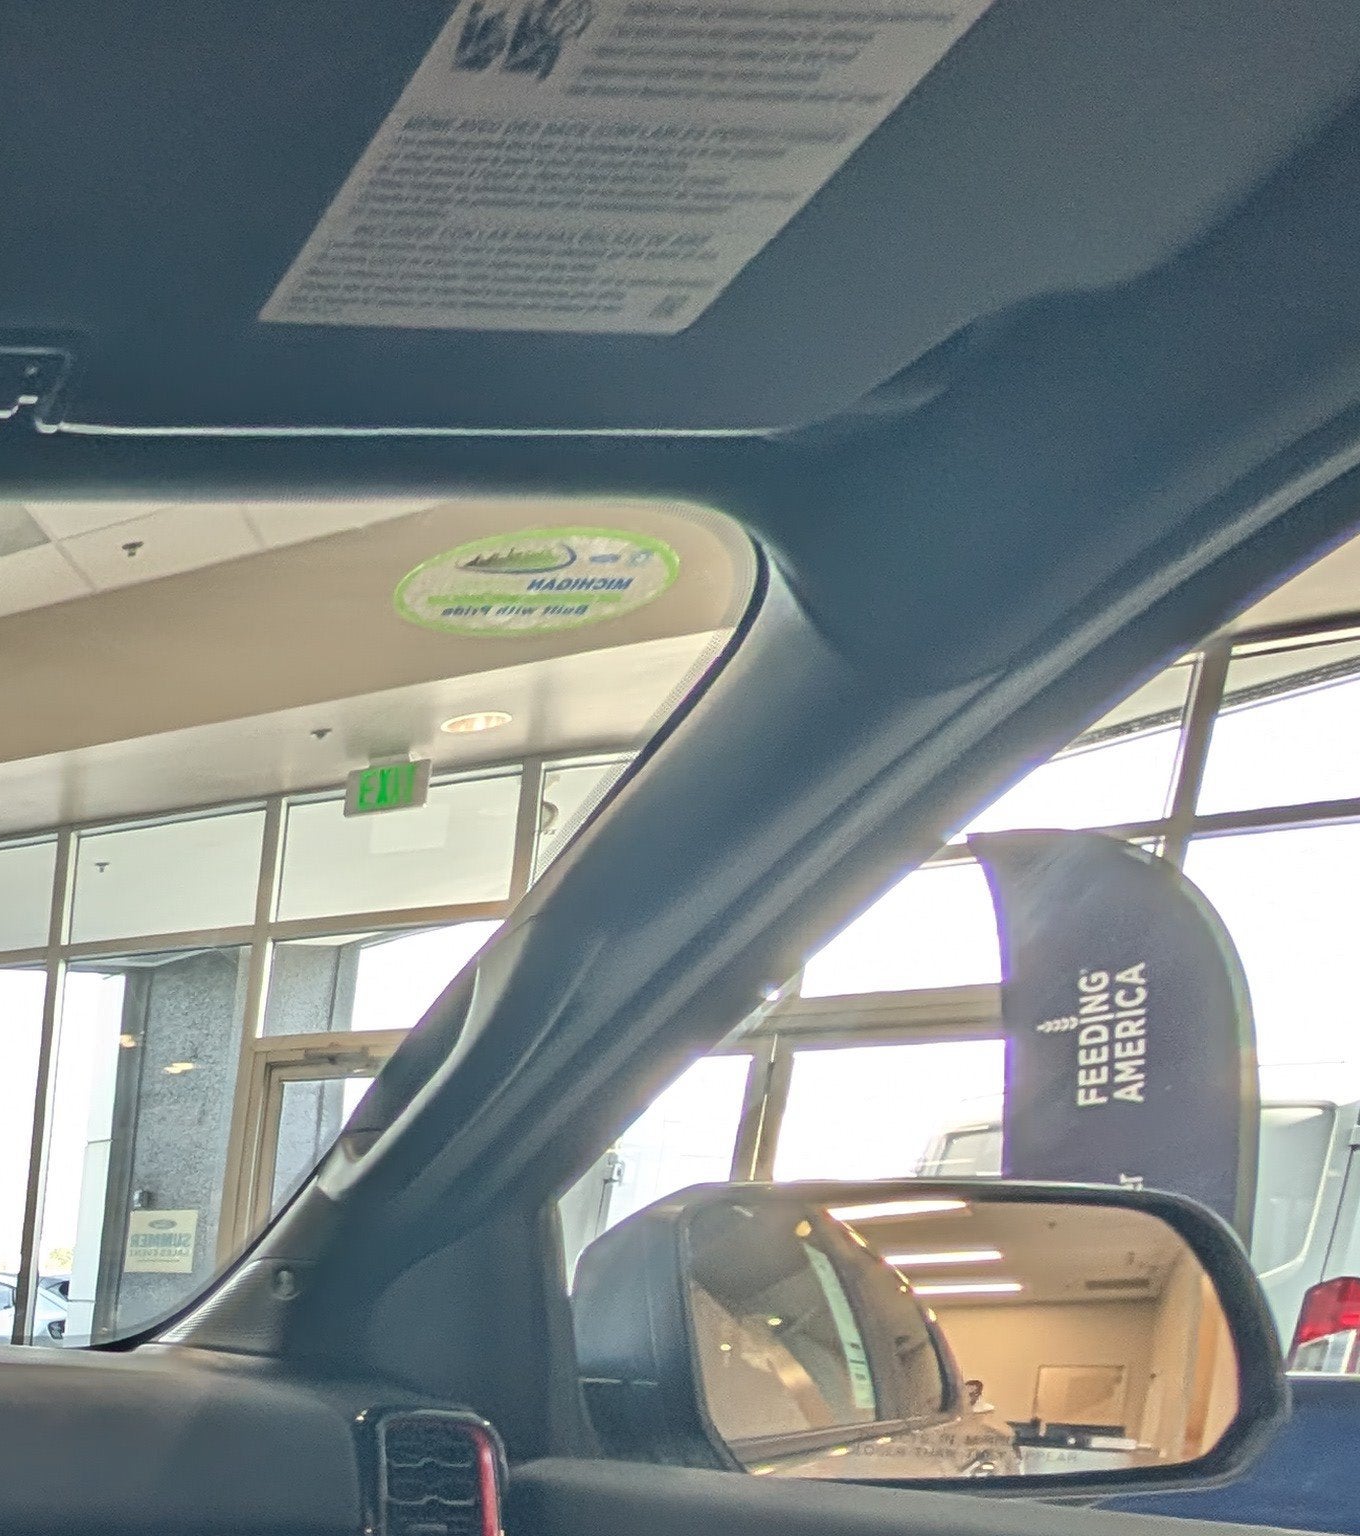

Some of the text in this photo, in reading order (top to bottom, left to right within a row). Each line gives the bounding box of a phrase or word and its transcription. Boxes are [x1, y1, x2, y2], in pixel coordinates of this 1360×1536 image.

[357, 762, 417, 812] EXIT
[1077, 969, 1113, 1107] FEEDING
[1113, 961, 1147, 1103] AMERICA
